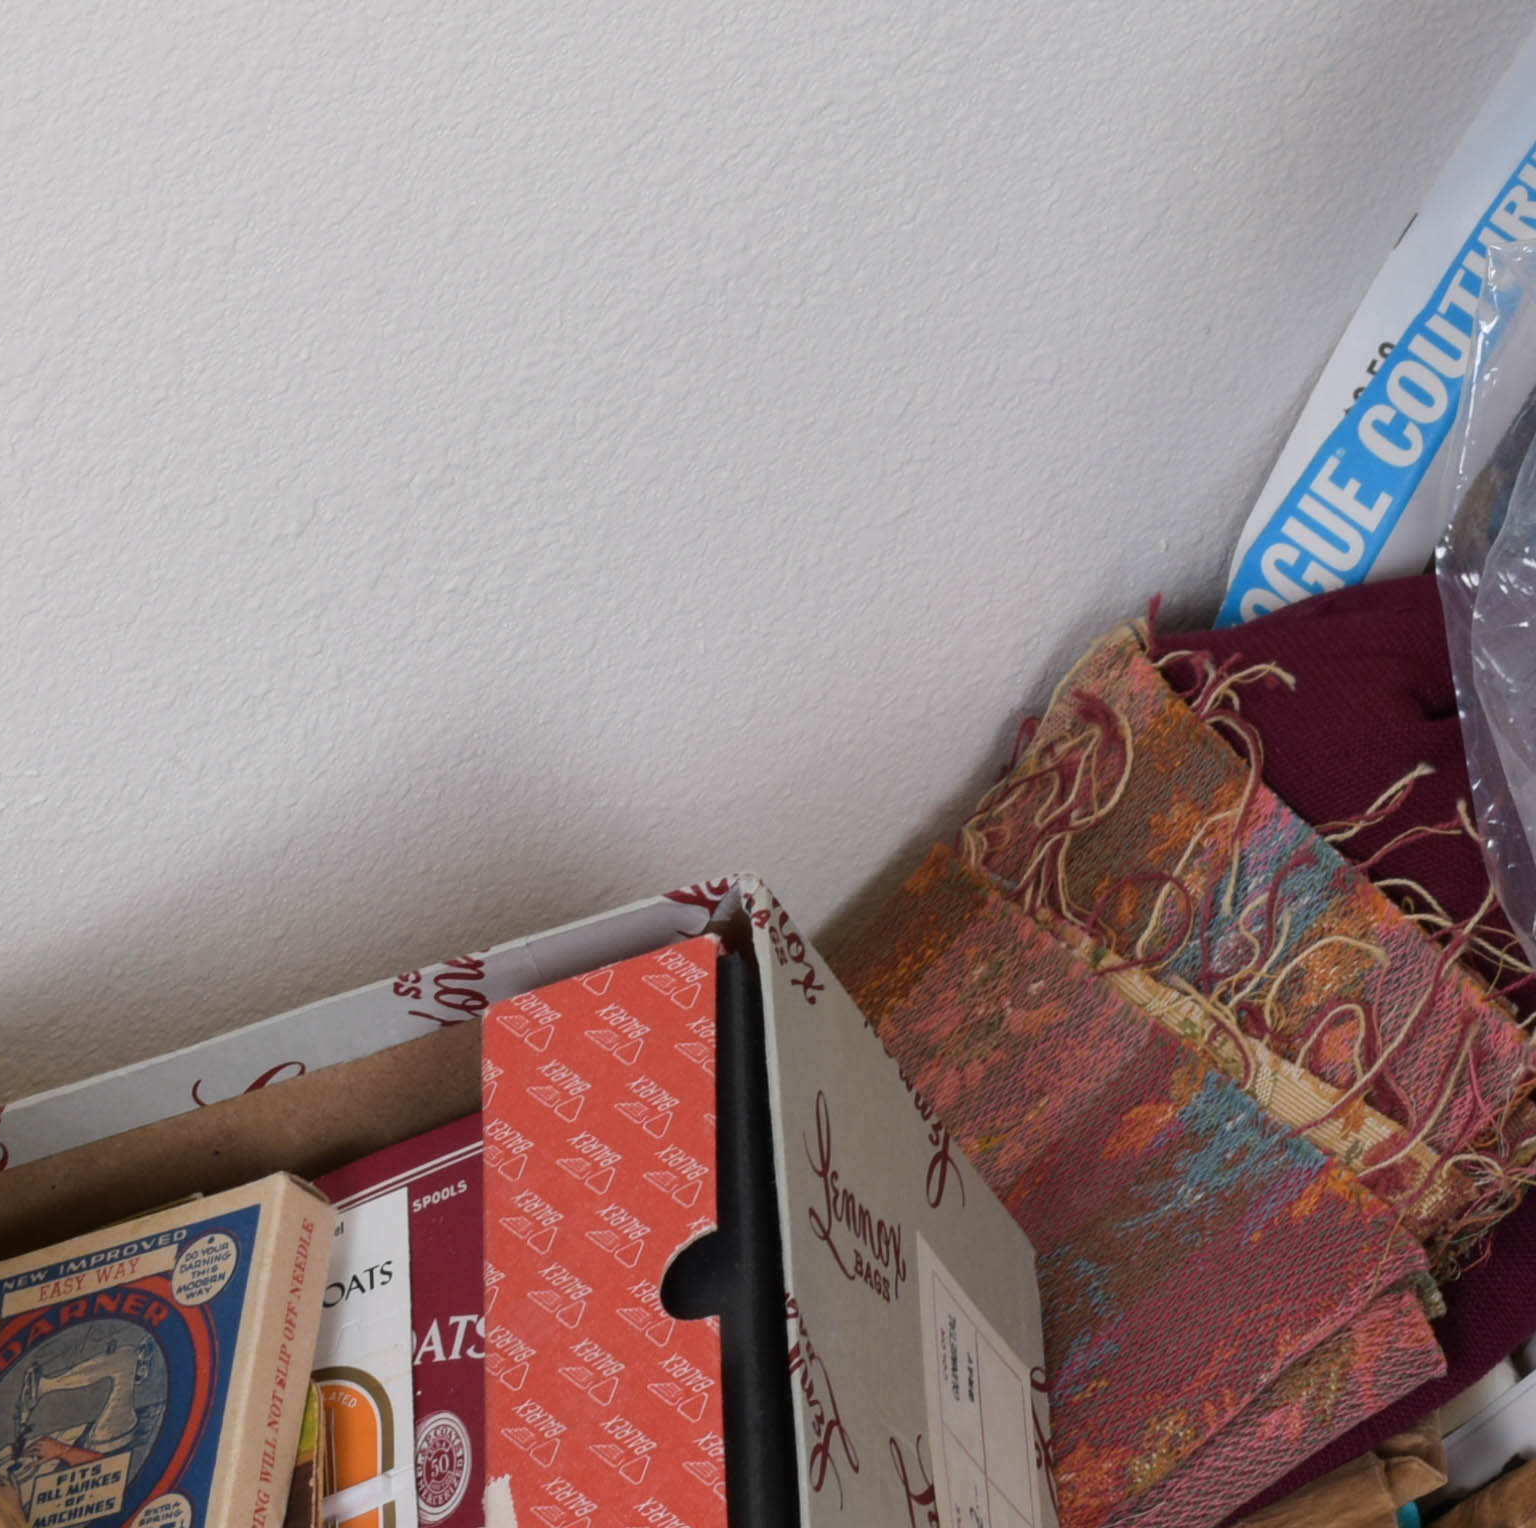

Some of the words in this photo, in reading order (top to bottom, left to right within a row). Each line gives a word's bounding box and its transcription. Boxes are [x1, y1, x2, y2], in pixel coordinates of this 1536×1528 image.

[1236, 456, 1394, 622] OGUE
[655, 948, 709, 984] BALREX
[595, 1002, 653, 1041] BALREX
[536, 1058, 593, 1097] BALREX
[626, 1074, 681, 1113] BALREX
[482, 1117, 536, 1155] BALREX
[655, 1143, 710, 1182] BALREX
[411, 1180, 468, 1213] SPOOLS
[803, 1089, 906, 1299] Lennox
[595, 1202, 653, 1241] BALREX
[1, 1268, 48, 1293] NEW
[59, 1229, 188, 1274] IMPROVED
[179, 1251, 232, 1272] DARNING
[185, 1249, 202, 1262] DO
[202, 1241, 230, 1257] YOUR
[289, 1217, 314, 1303] NEEDLE
[38, 1276, 86, 1302] EASY
[96, 1256, 143, 1281] WAY
[175, 1272, 227, 1295] MODERN
[190, 1265, 219, 1279] THIS
[541, 1259, 595, 1297] BALREX
[852, 1248, 892, 1304] BAGS
[185, 1285, 214, 1300] WAY
[283, 1307, 298, 1346] OFF
[274, 1349, 291, 1393] SLIP
[657, 1351, 716, 1391] BALREX
[267, 1396, 283, 1434] NOT
[509, 1397, 568, 1441] BALREX
[57, 1464, 102, 1485] FITS
[257, 1434, 275, 1489] WILL
[430, 1454, 451, 1479] 50
[36, 1486, 62, 1504] ALL
[66, 1470, 122, 1497] MAKES
[139, 1509, 184, 1528] SPRING
[143, 1501, 181, 1517] EXTRA
